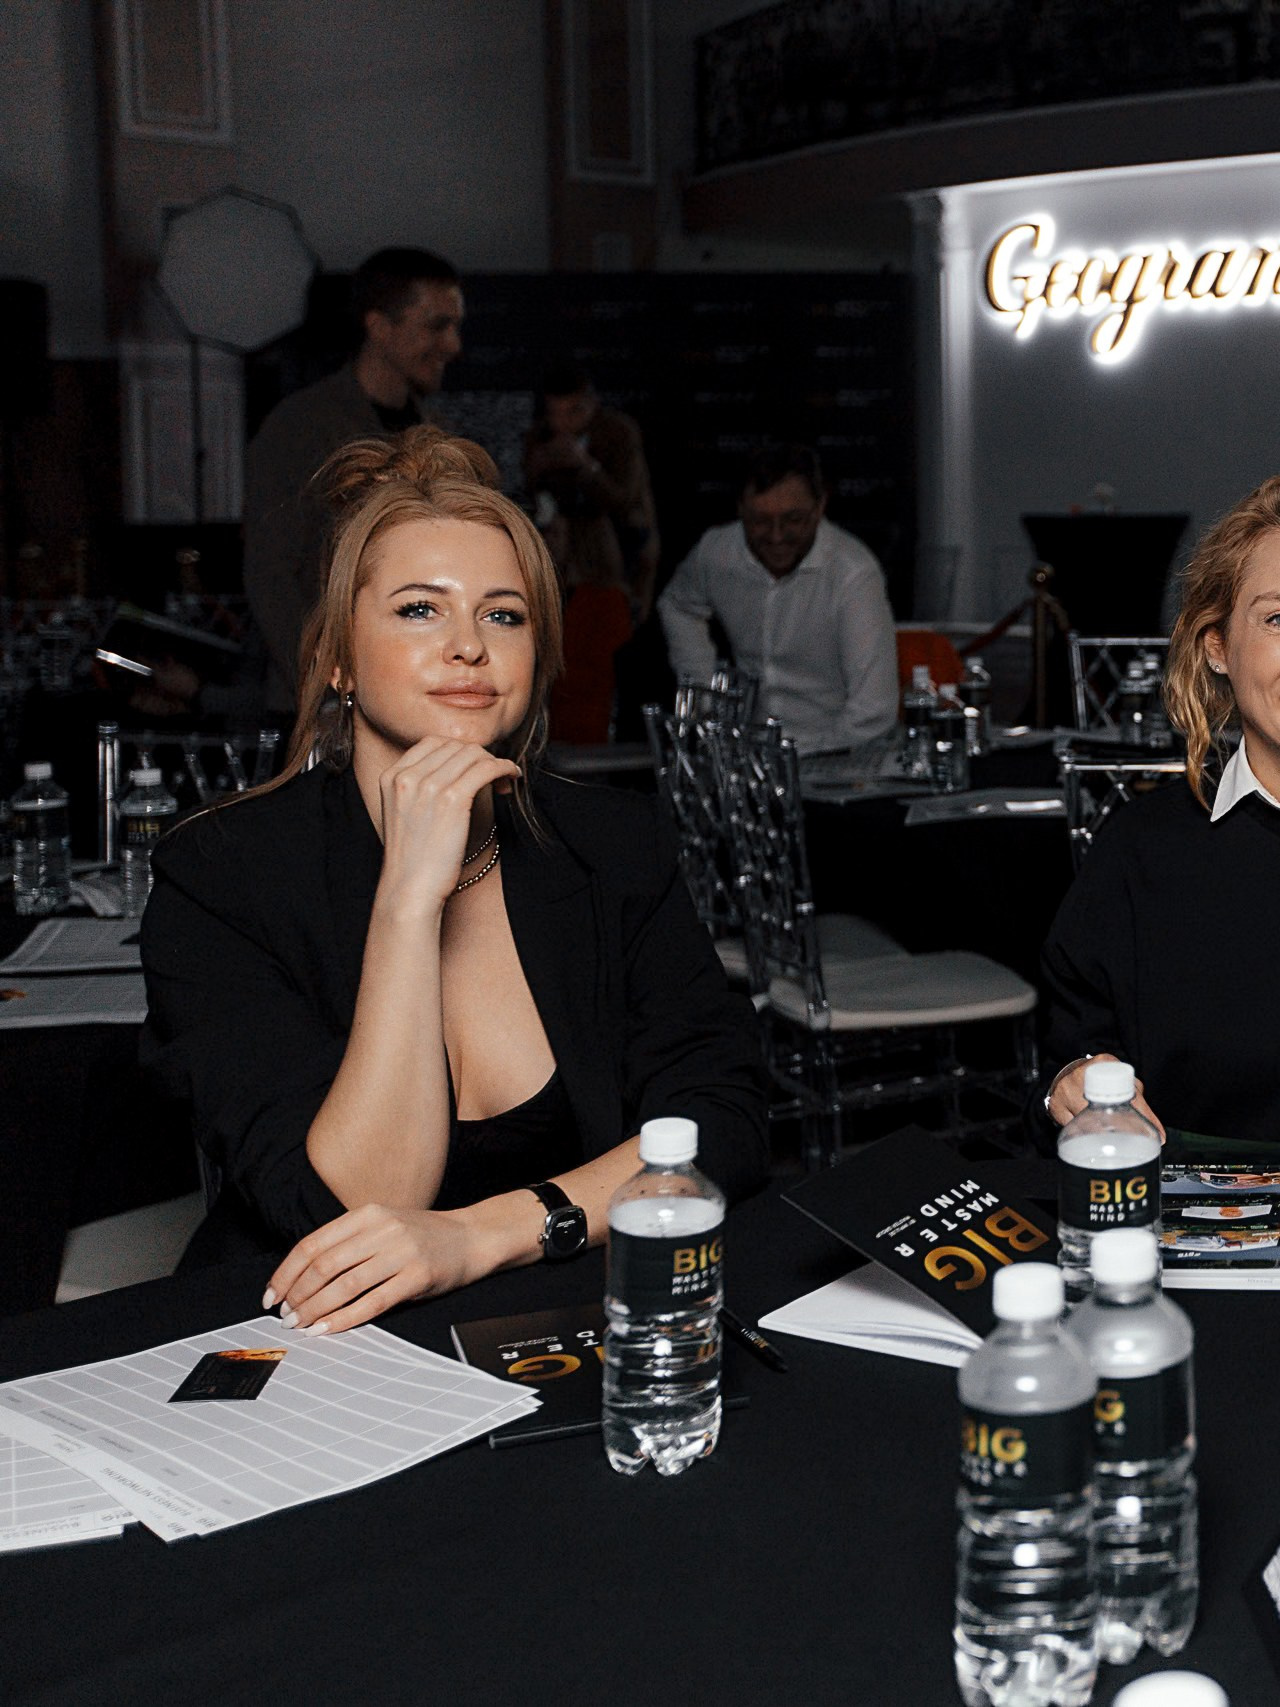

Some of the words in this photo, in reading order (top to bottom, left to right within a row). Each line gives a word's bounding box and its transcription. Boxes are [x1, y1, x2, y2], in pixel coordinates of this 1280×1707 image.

[920, 1179, 981, 1217] MIND
[1089, 1198, 1147, 1213] MASTER
[1090, 1176, 1147, 1203] BIG
[894, 1192, 1000, 1258] MASTER
[1089, 1212, 1125, 1222] MIND
[924, 1206, 1049, 1290] BIG
